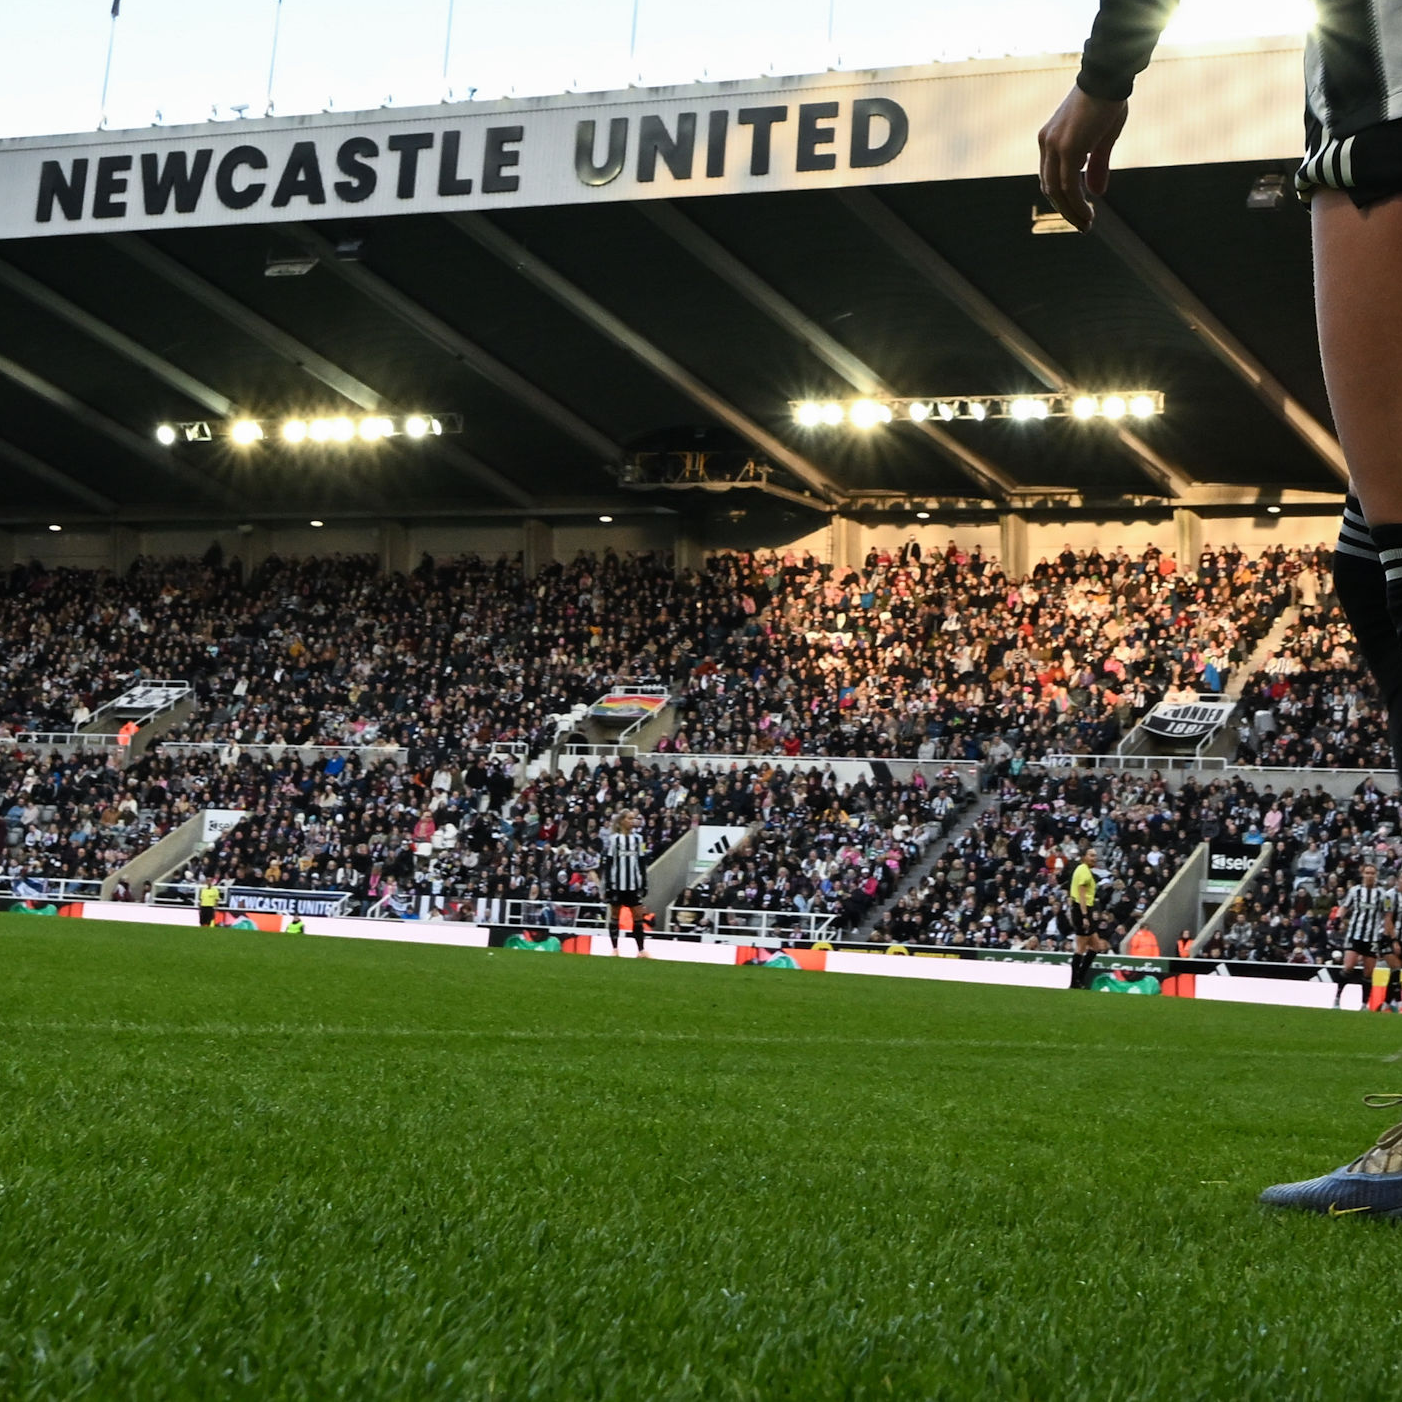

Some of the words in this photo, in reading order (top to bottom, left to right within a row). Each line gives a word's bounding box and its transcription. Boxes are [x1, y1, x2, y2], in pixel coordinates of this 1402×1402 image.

[34, 124, 525, 224] NEWCASTLE
[574, 96, 911, 188] UNITED
[1163, 704, 1225, 722] OUNDED
